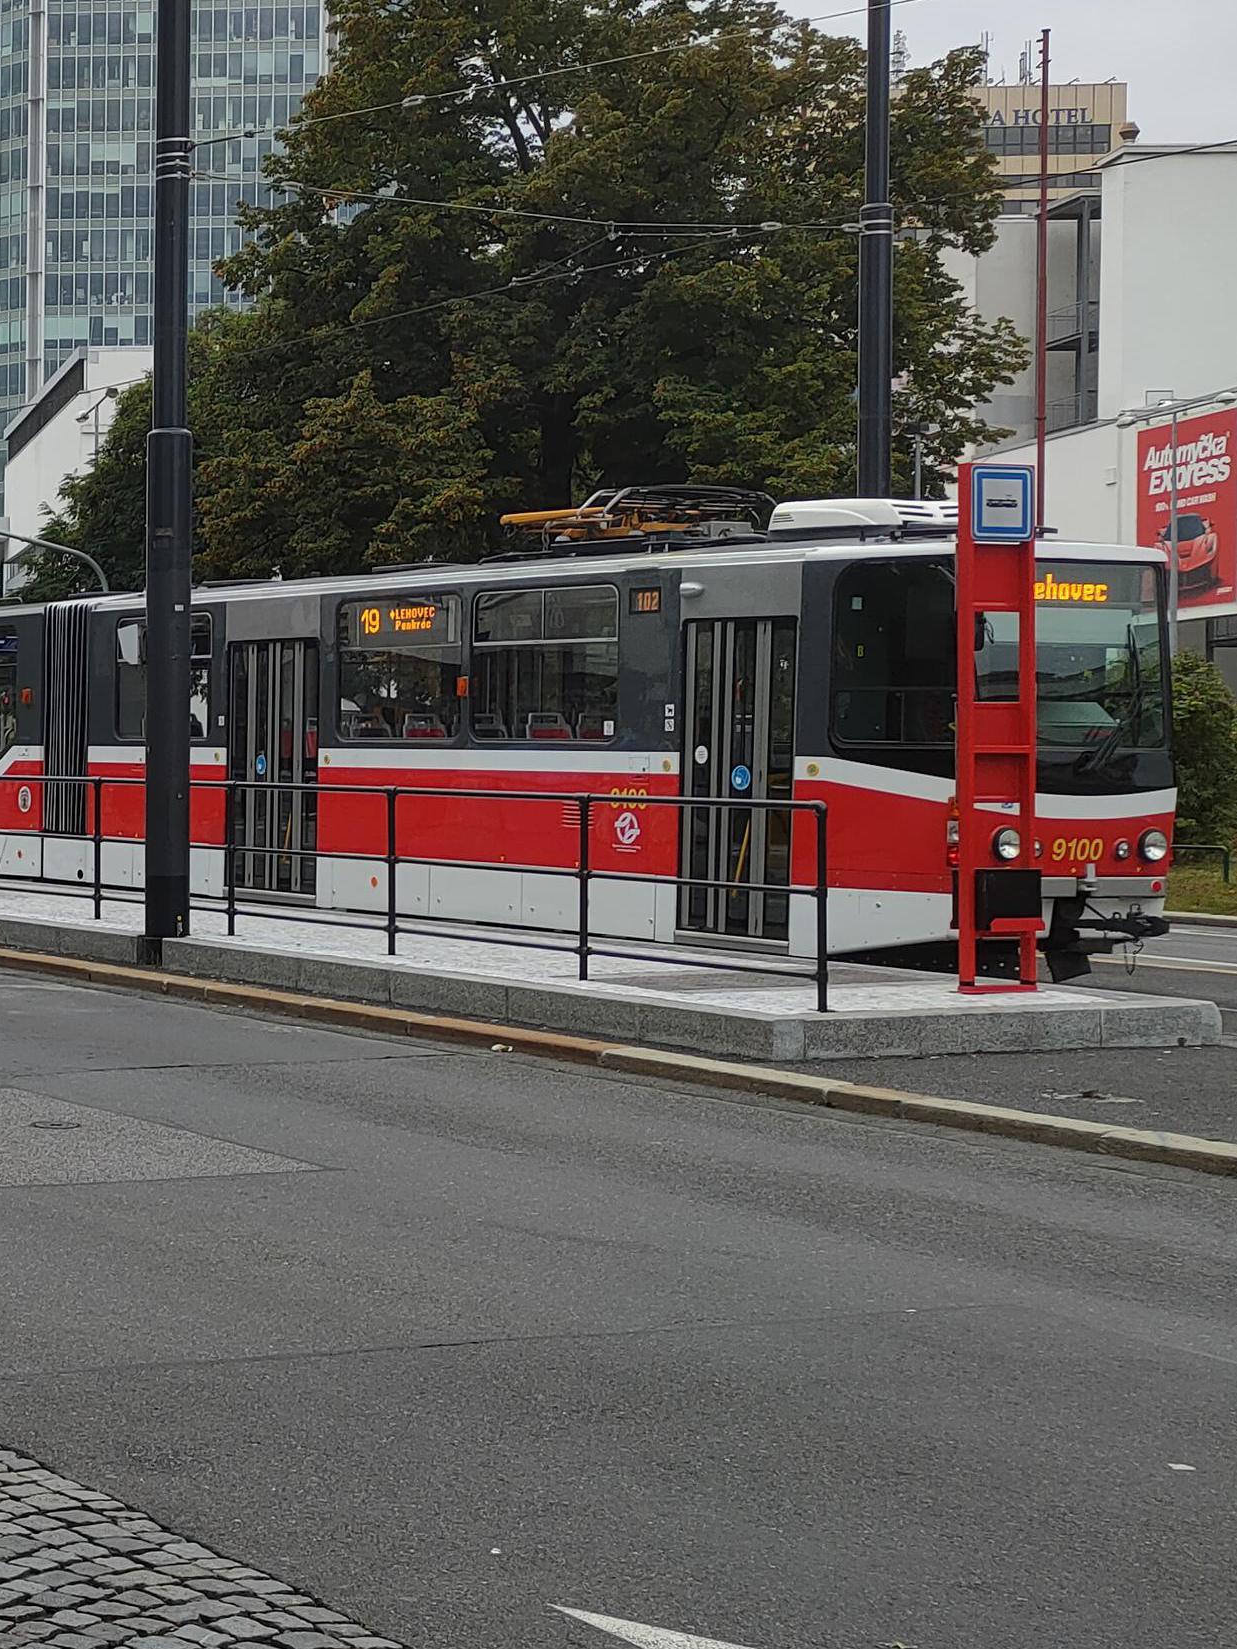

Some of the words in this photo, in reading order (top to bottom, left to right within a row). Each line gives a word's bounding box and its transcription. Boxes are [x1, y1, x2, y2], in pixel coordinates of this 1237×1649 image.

[1013, 107, 1093, 126] HOTEL
[1033, 573, 1108, 602] ehovec
[637, 591, 660, 611] 102
[361, 608, 380, 634] 19
[1051, 838, 1104, 861] 9100
